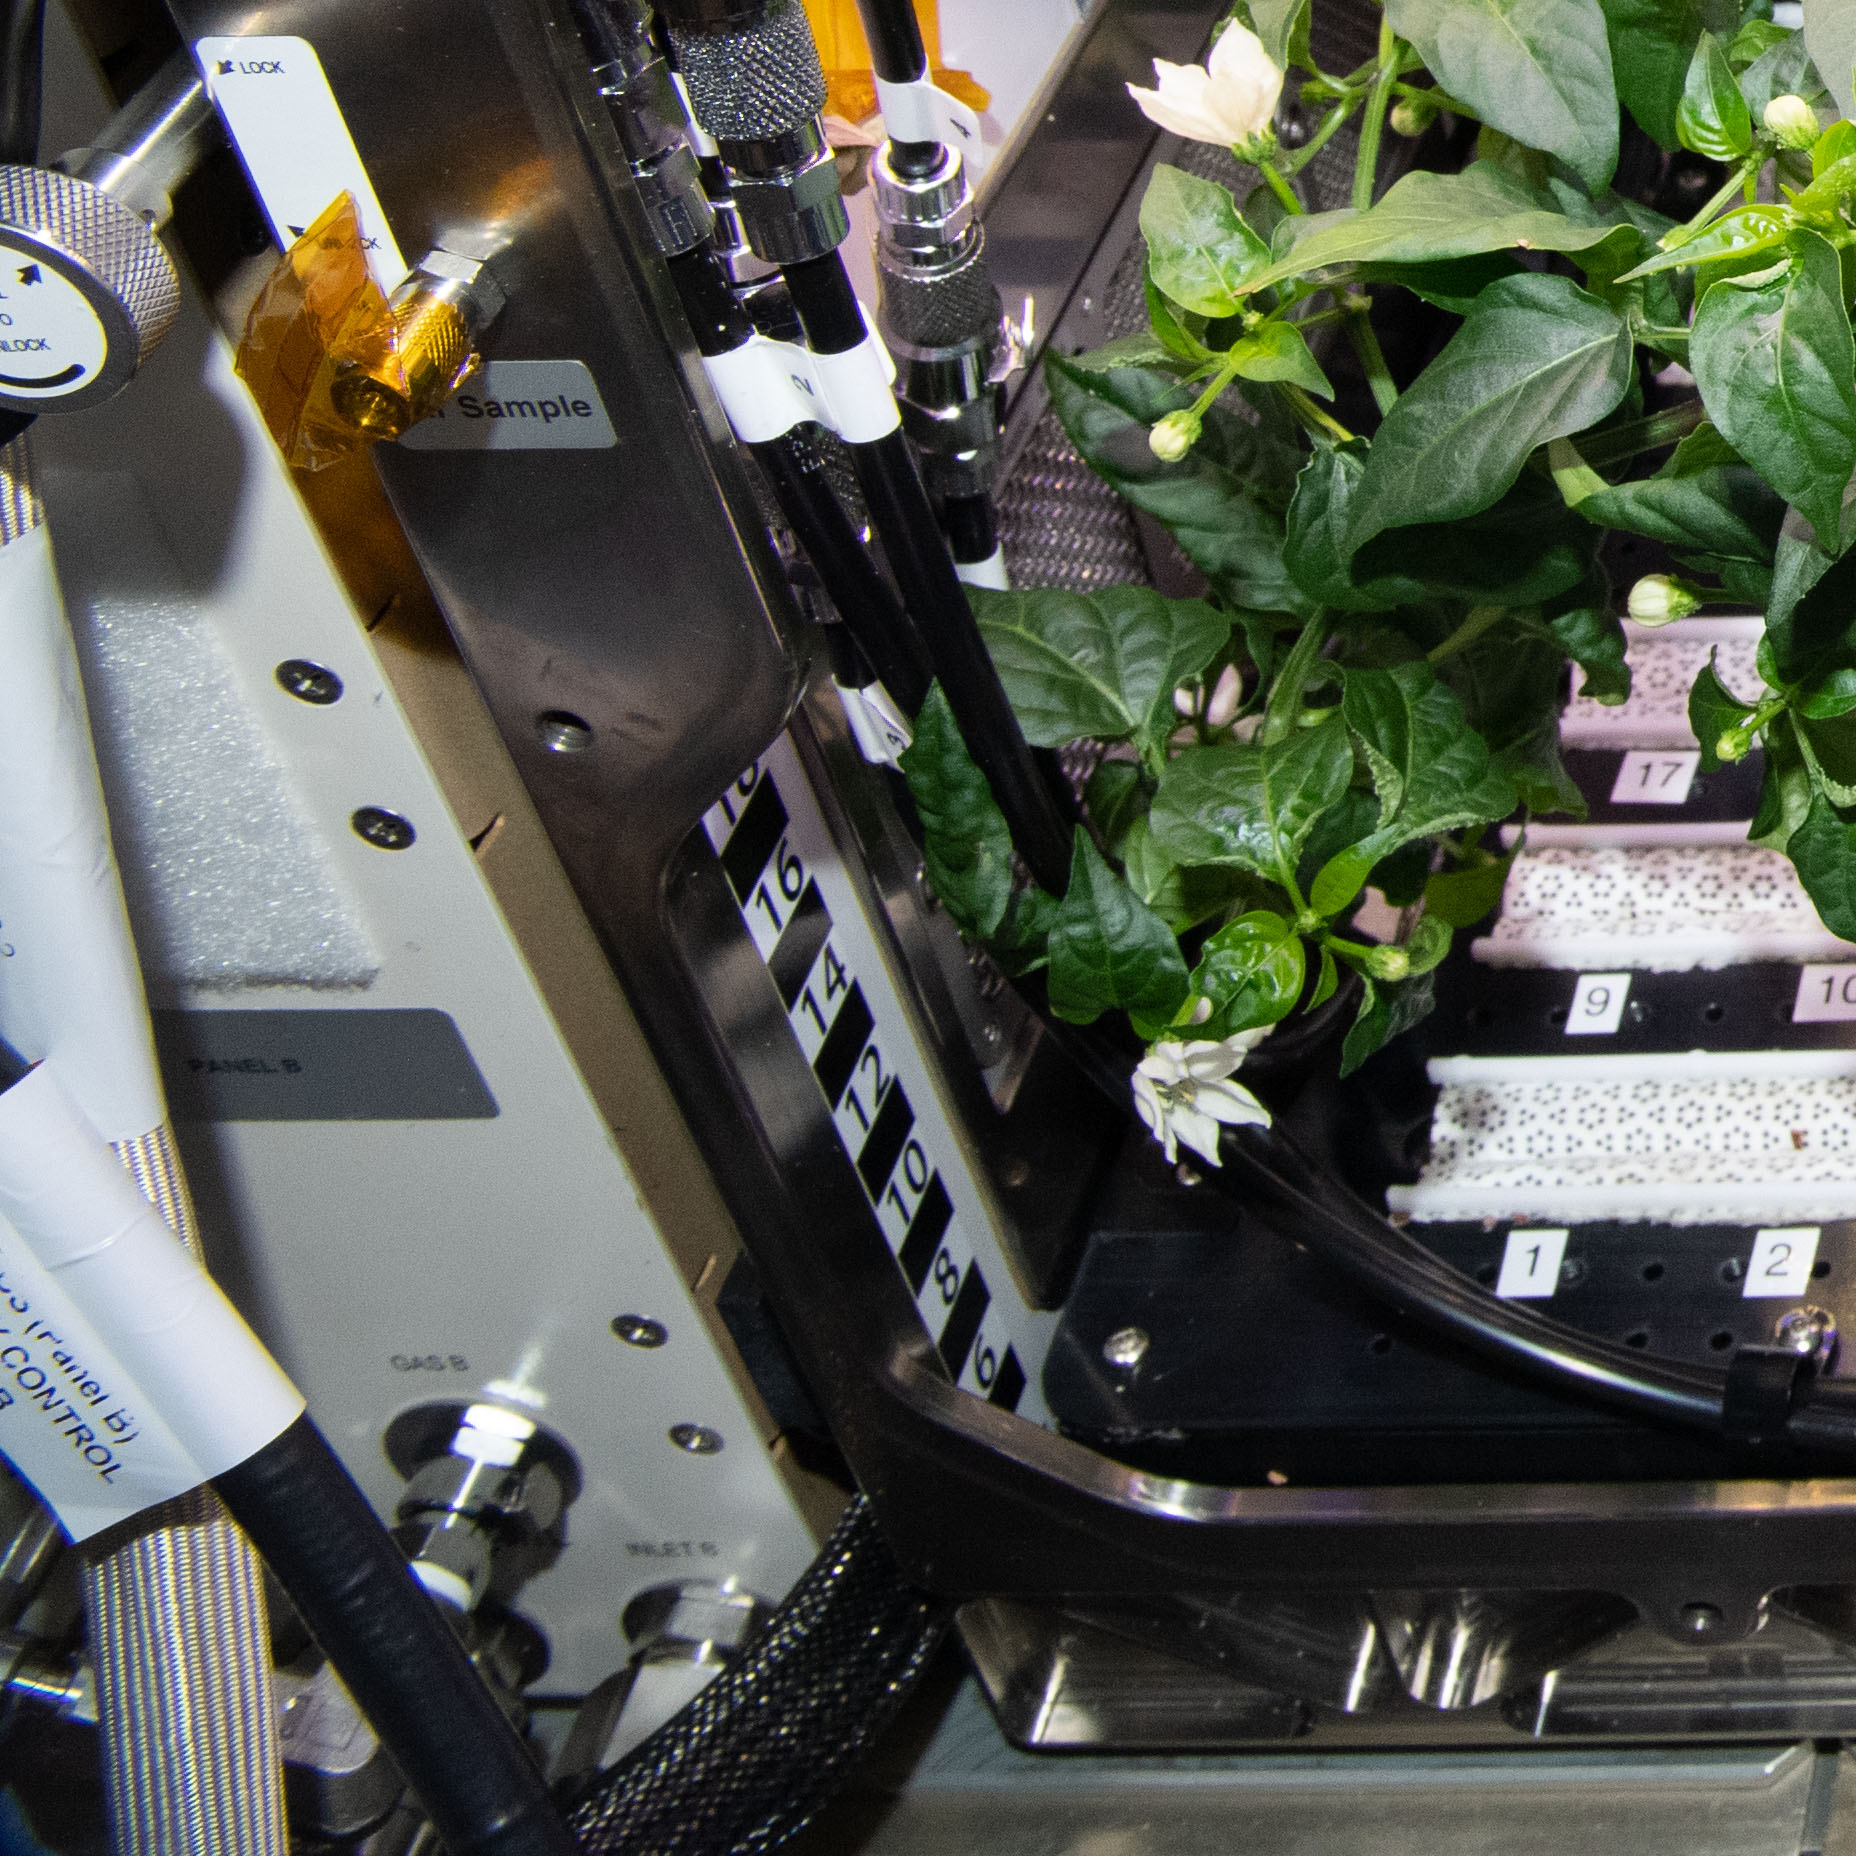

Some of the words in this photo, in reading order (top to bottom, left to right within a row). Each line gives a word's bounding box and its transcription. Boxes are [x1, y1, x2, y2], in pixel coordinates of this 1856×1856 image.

[240, 60, 285, 75] LOCK
[456, 394, 594, 424] Sample
[1639, 761, 1684, 789] 17
[755, 836, 804, 934] 16
[801, 941, 848, 1036] 14
[1585, 987, 1611, 1017] 9
[844, 1043, 892, 1133] 12
[886, 1138, 929, 1226] 10
[934, 1247, 960, 1306] 8
[1526, 1244, 1541, 1277] 1
[1765, 1242, 1793, 1276] 2
[974, 1332, 997, 1390] 6
[1, 1345, 123, 1485] CONTROL
